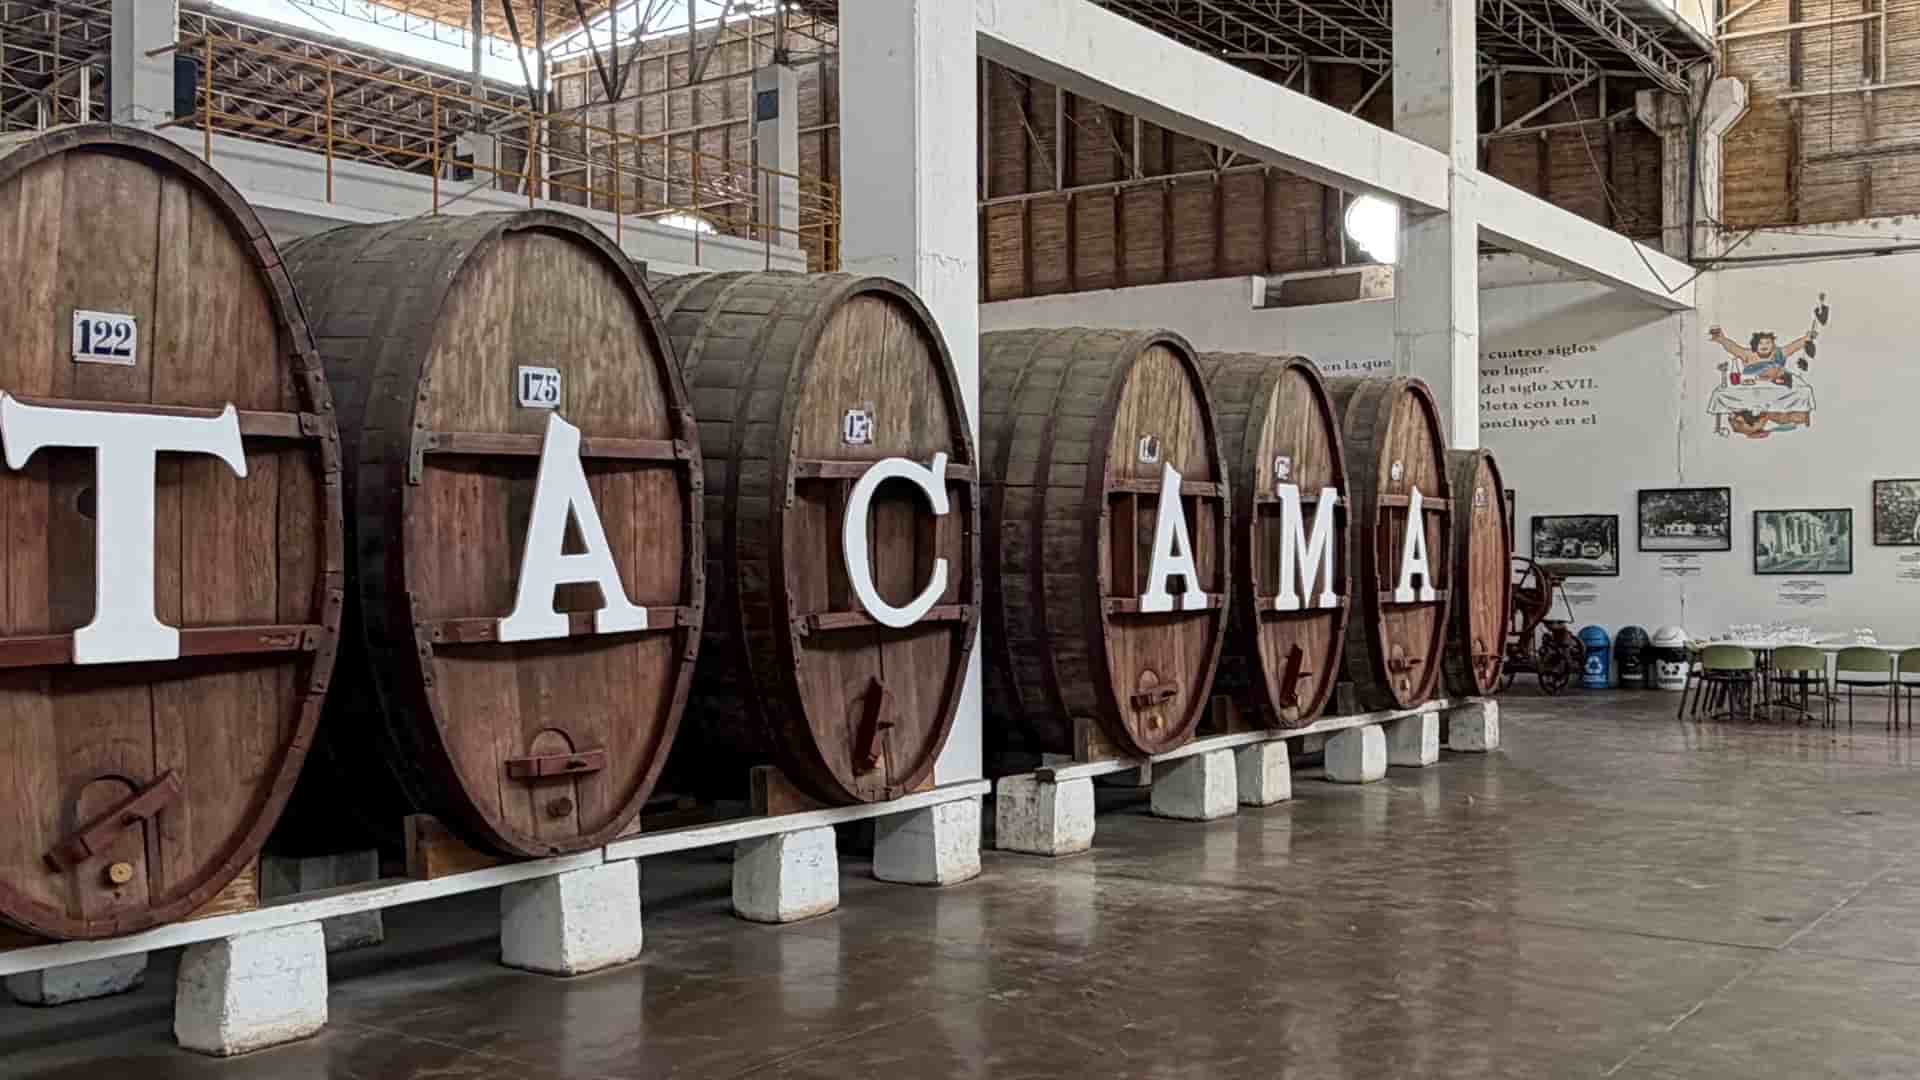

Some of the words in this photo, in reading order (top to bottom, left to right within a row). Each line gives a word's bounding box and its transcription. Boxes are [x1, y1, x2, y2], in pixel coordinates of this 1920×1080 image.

[78, 319, 131, 356] 122
[1488, 349, 1543, 360] cuatro
[1547, 343, 1598, 357] siglos
[523, 372, 557, 401] 175
[1481, 383, 1505, 394] del
[1509, 382, 1548, 395] siglo
[1551, 378, 1599, 391] XVII.
[1522, 400, 1557, 409] con
[1562, 397, 1591, 407] los
[1581, 413, 1597, 425] el
